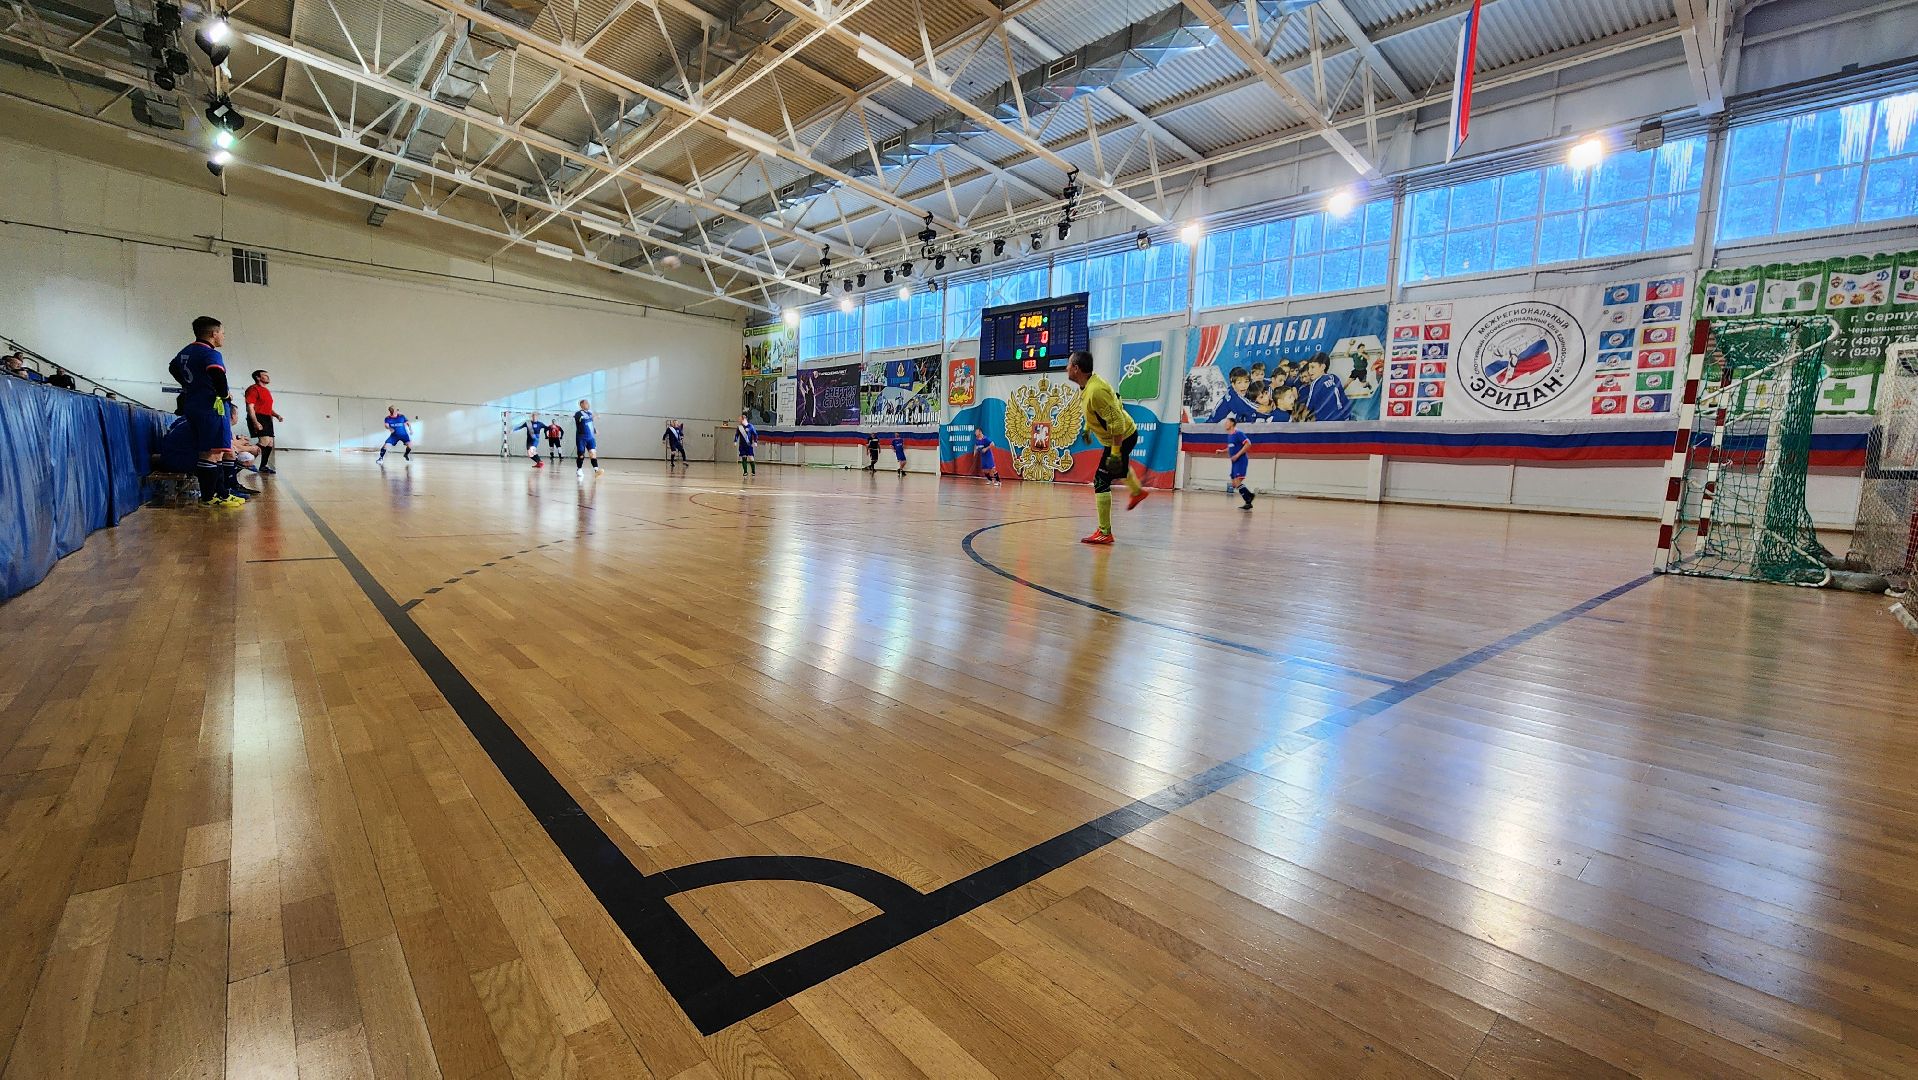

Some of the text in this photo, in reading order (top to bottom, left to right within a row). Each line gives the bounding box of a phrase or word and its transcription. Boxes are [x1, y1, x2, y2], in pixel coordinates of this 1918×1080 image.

[1235, 317, 1327, 347] ГАНДБОЛ
[1477, 307, 1570, 335] МЕЖРЕГИОНАЛЬНЫЙ
[1246, 344, 1322, 358] ПРОТВИНО
[1831, 347, 1881, 358] +7 (925)
[1833, 338, 1848, 347] +7
[1851, 335, 1891, 347] (4967)
[180, 354, 194, 384] 3
[1470, 377, 1564, 409] ЭРИДАН
